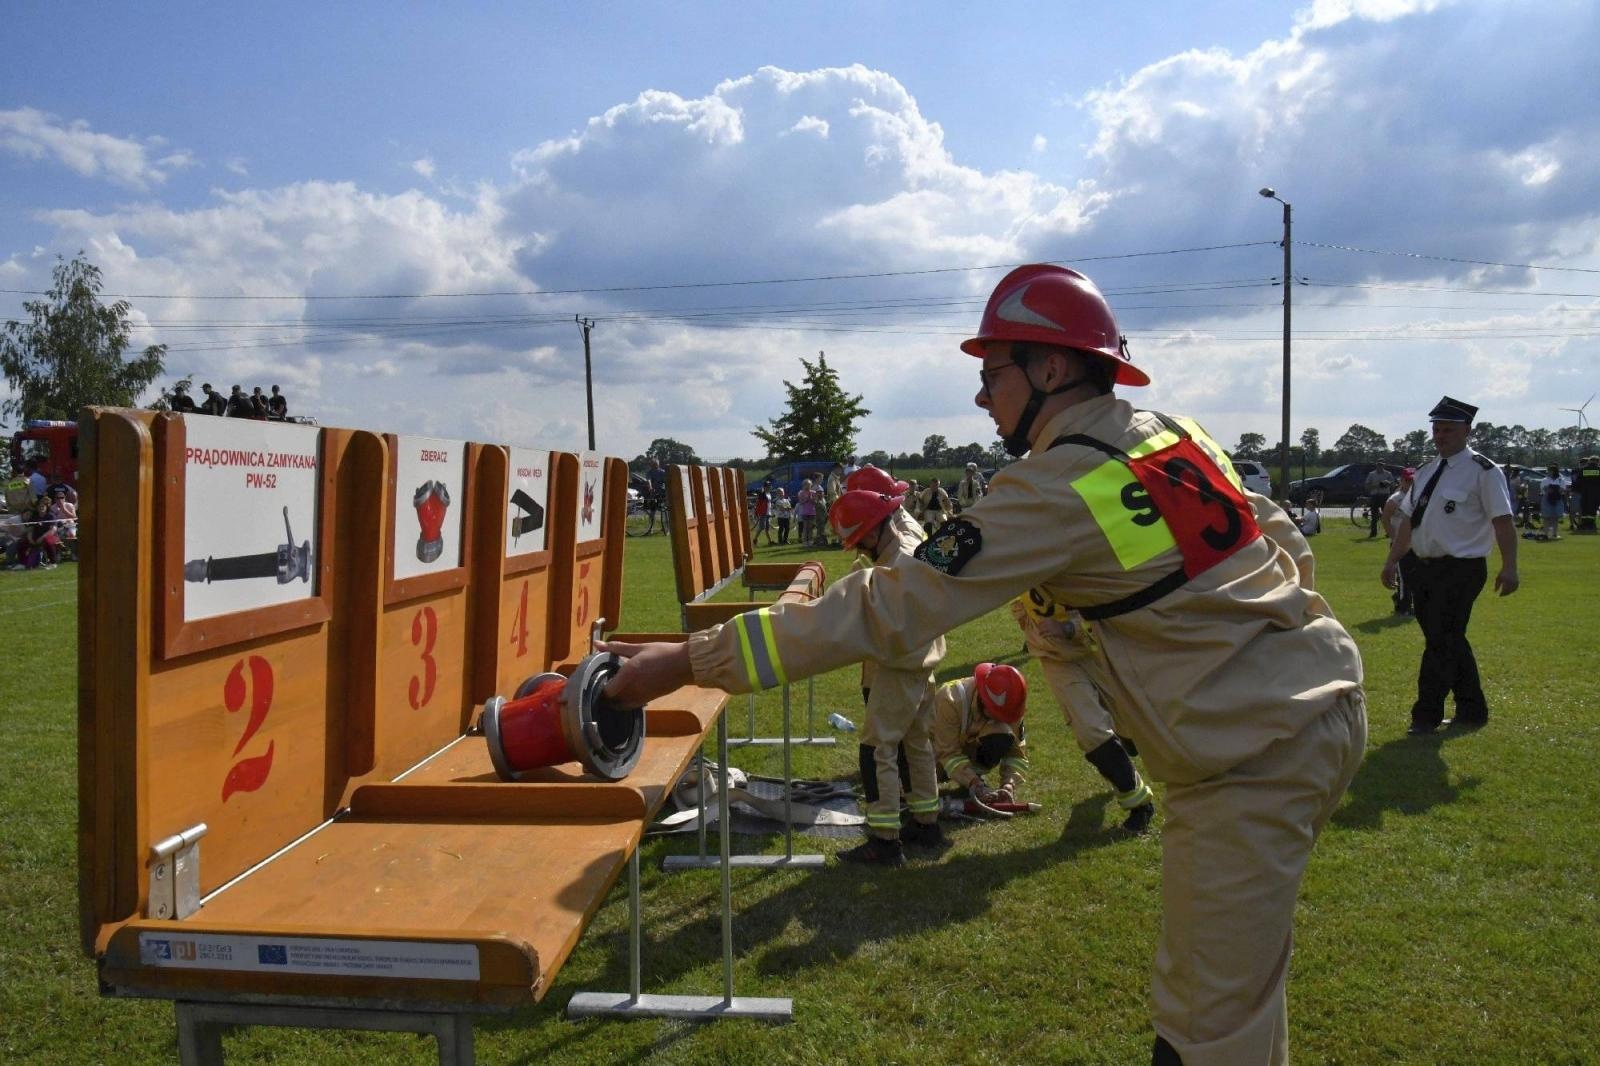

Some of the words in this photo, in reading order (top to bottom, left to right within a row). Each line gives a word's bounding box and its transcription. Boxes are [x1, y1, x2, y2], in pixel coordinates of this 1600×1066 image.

[185, 447, 265, 469] PRĄDOWNICA
[267, 452, 317, 470] ZAMYKANA
[246, 472, 277, 489] PW-52
[420, 449, 448, 463] ZBIERACZ
[1120, 481, 1161, 527] S
[1164, 456, 1242, 550] 3
[510, 579, 529, 658] 4
[576, 562, 591, 629] 5
[408, 606, 438, 711] 3
[221, 655, 275, 804] 2
